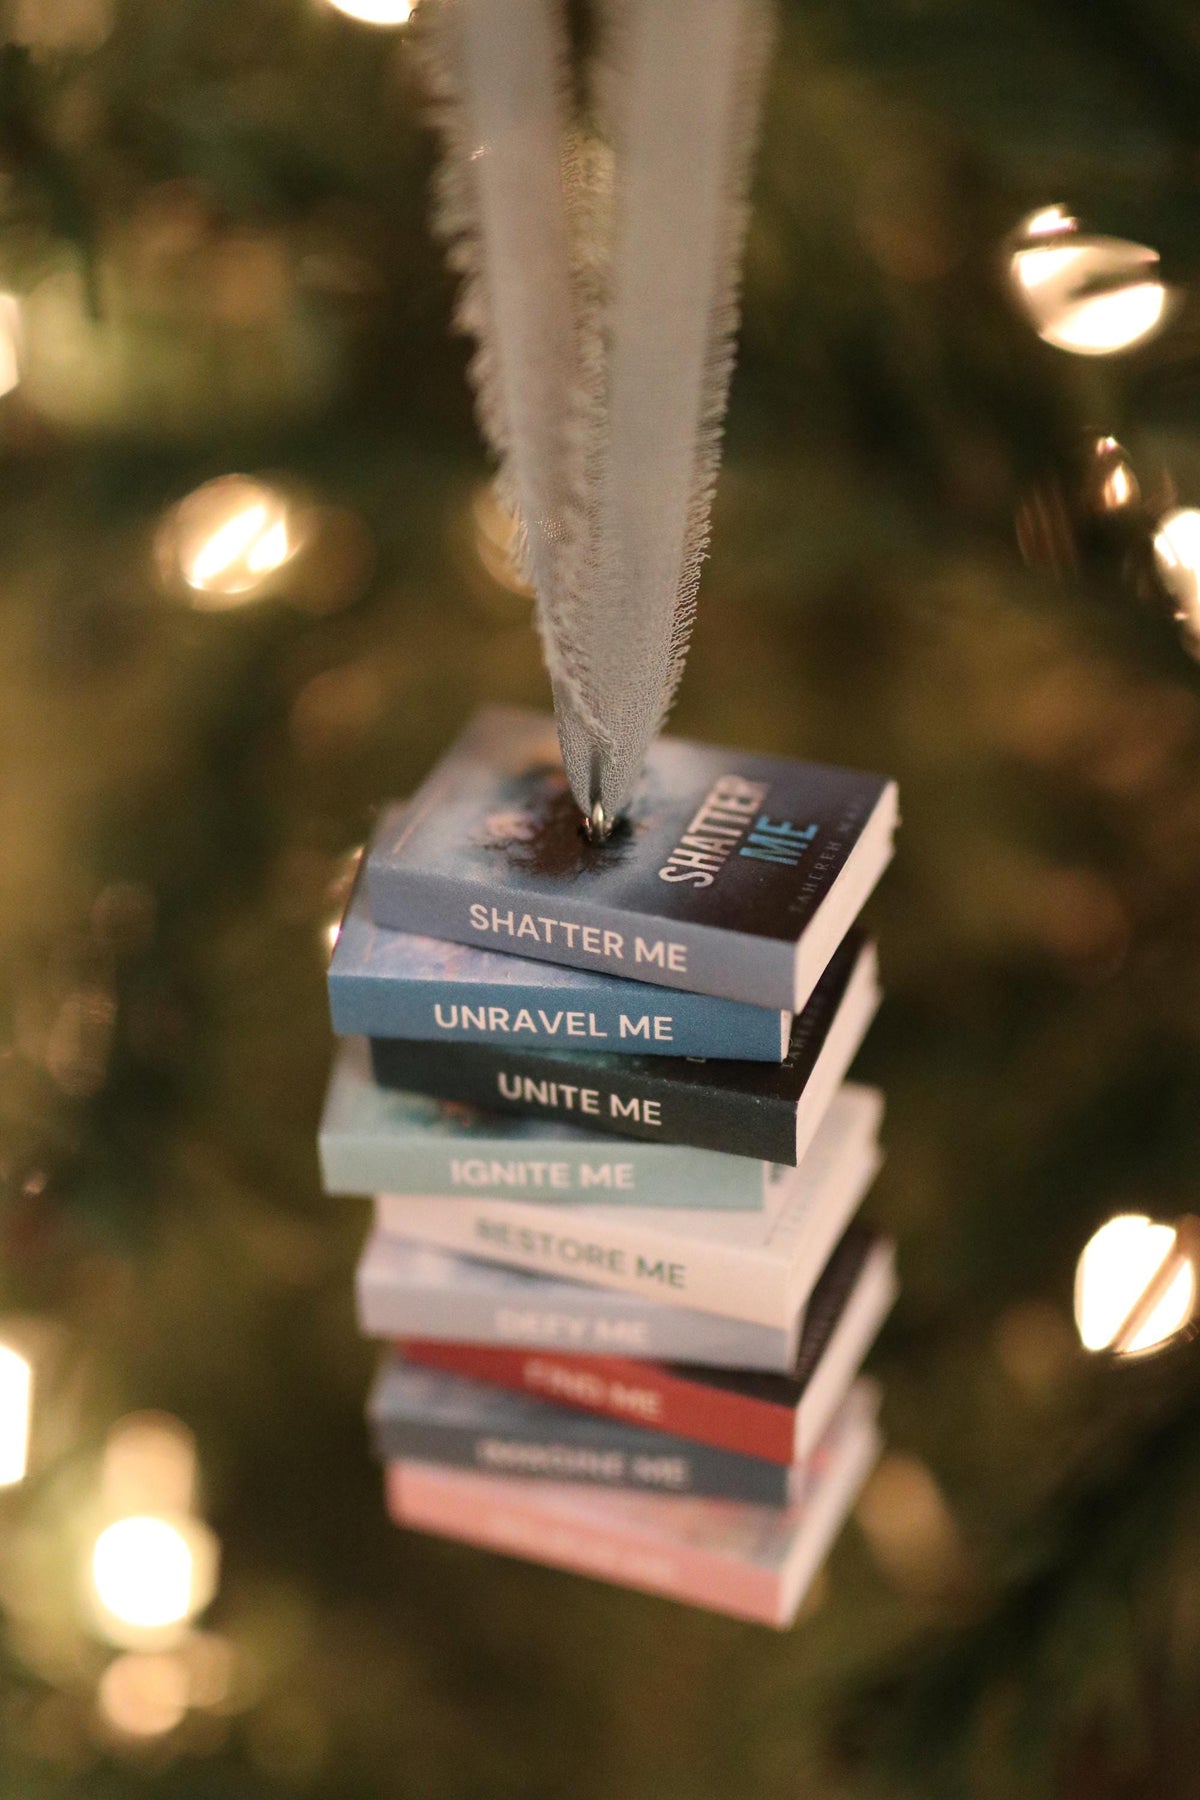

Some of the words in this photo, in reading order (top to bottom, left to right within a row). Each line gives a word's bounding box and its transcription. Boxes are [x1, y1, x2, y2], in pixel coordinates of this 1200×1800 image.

[658, 775, 769, 888] SHATTER
[739, 815, 819, 866] ME
[469, 903, 624, 960] SHATTER
[634, 936, 688, 973] ME
[434, 1003, 608, 1038] UNRAVEL
[619, 1014, 674, 1042] ME
[498, 1072, 601, 1116] UNITE
[610, 1094, 662, 1126] ME
[450, 1158, 571, 1189] IGNITE
[579, 1162, 636, 1190] ME
[475, 1216, 626, 1276] RESTORE
[636, 1253, 687, 1289] ME
[594, 1317, 650, 1346] ME
[608, 1382, 663, 1421] ME
